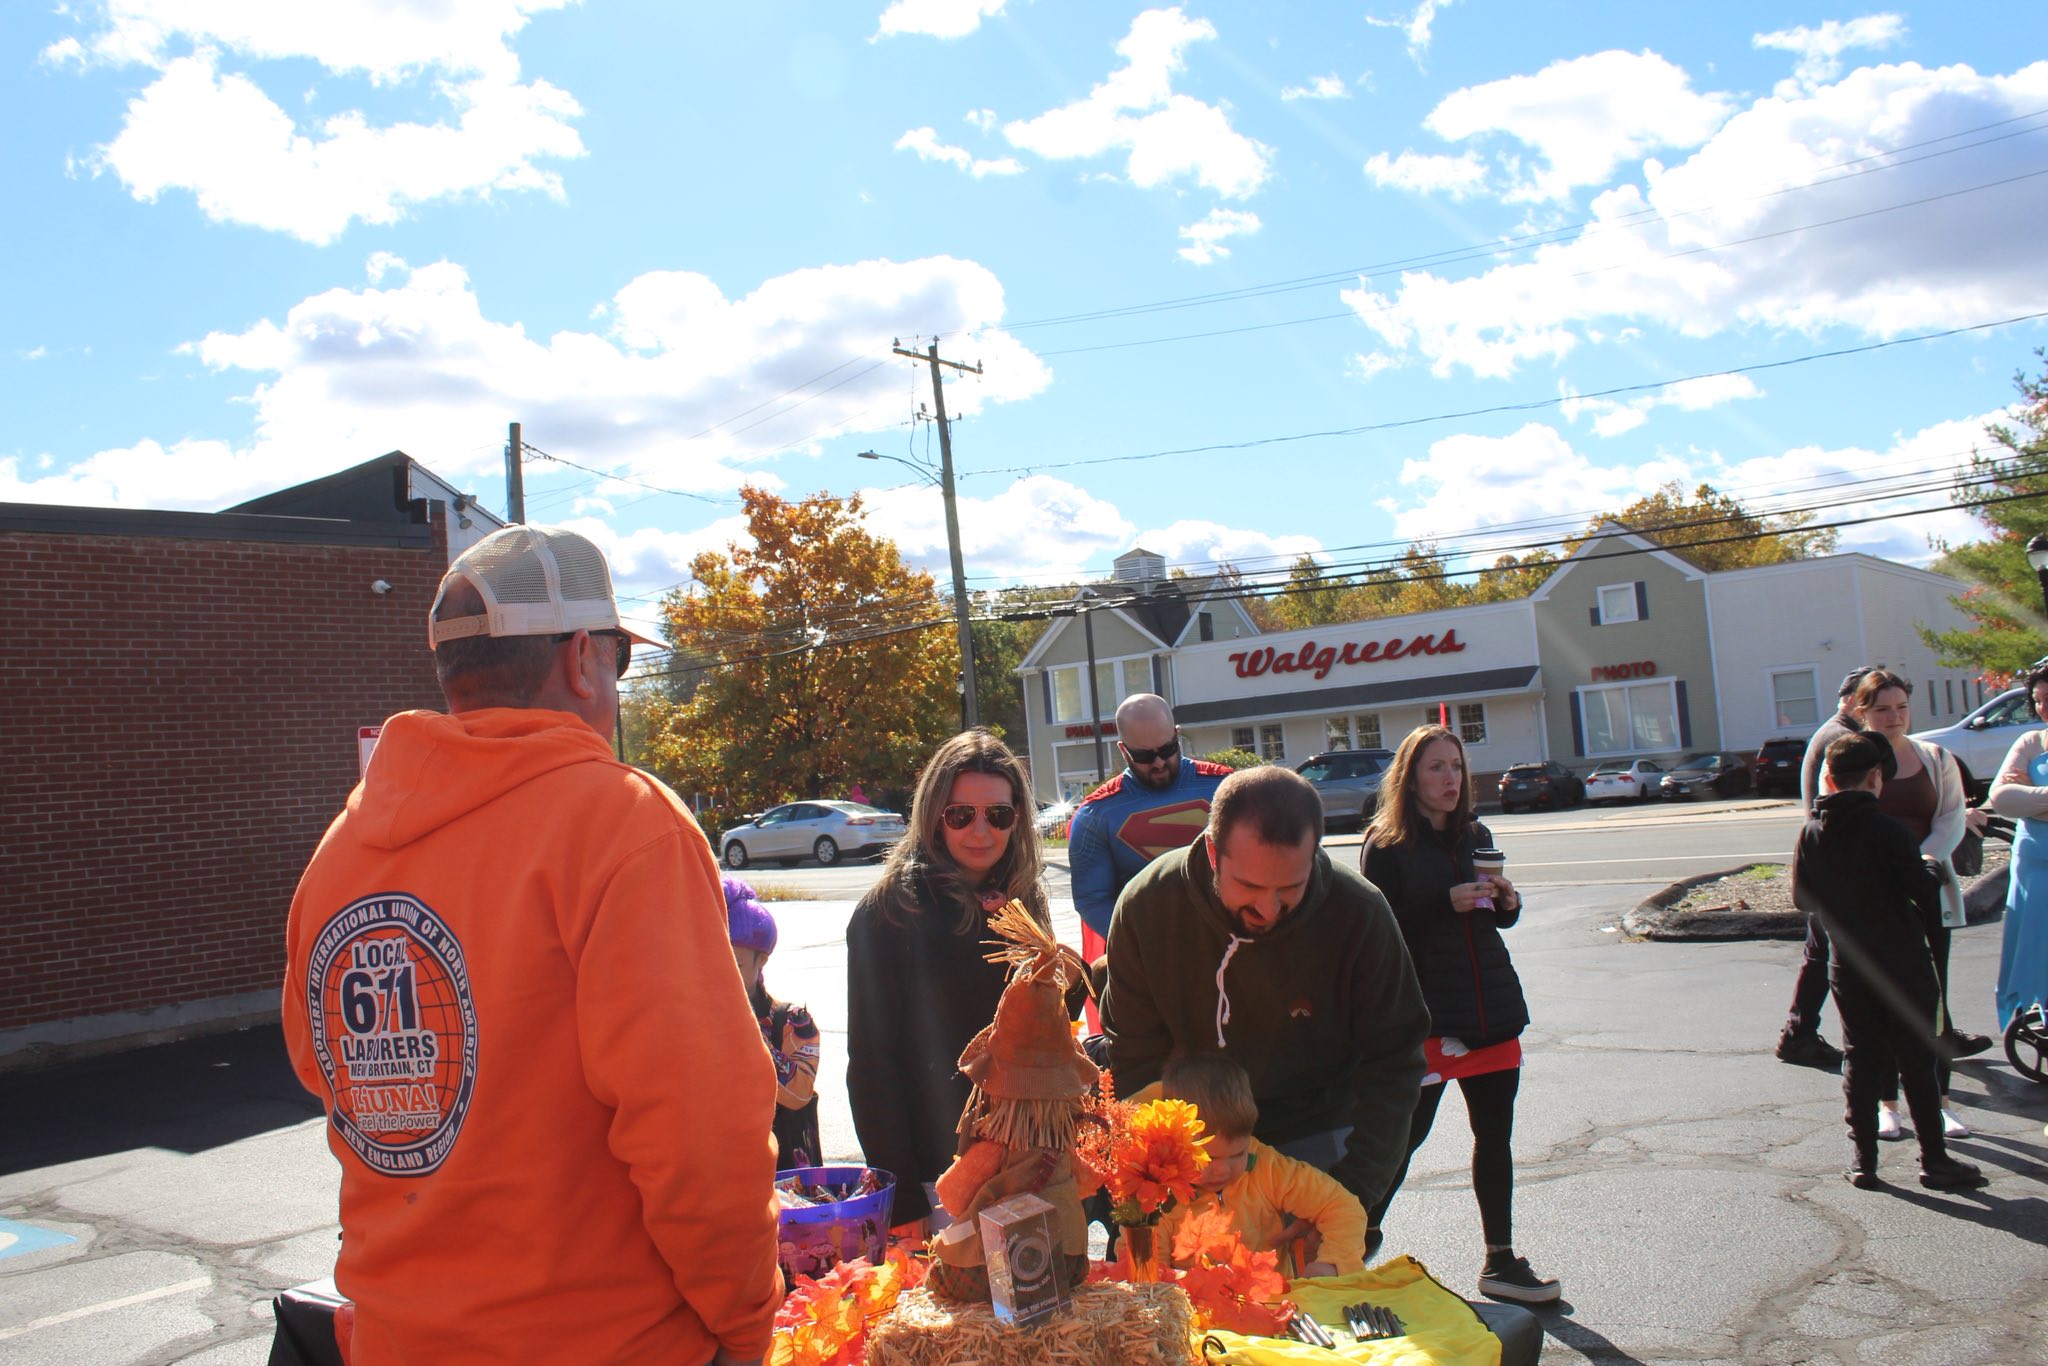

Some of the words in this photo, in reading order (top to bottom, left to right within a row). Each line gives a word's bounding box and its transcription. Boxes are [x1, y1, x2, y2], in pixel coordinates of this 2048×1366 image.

[1228, 628, 1467, 680] Walgreens
[1591, 660, 1656, 681] PHOTO
[311, 904, 386, 989] INTERNATIONAL
[391, 902, 420, 926] UNION
[421, 919, 439, 939] OF
[438, 936, 467, 992] NORTH
[354, 942, 406, 969] LOCAL
[342, 966, 417, 1034] 611
[342, 1034, 435, 1062] LABORERS
[351, 1062, 366, 1077] NEW
[417, 1059, 432, 1075] CT
[358, 1115, 377, 1129] Feel
[379, 1114, 397, 1129] the
[400, 1114, 438, 1129] Power
[343, 1124, 365, 1153] NEW
[367, 1146, 424, 1169] ENGLAND
[425, 1122, 455, 1163] REGION
